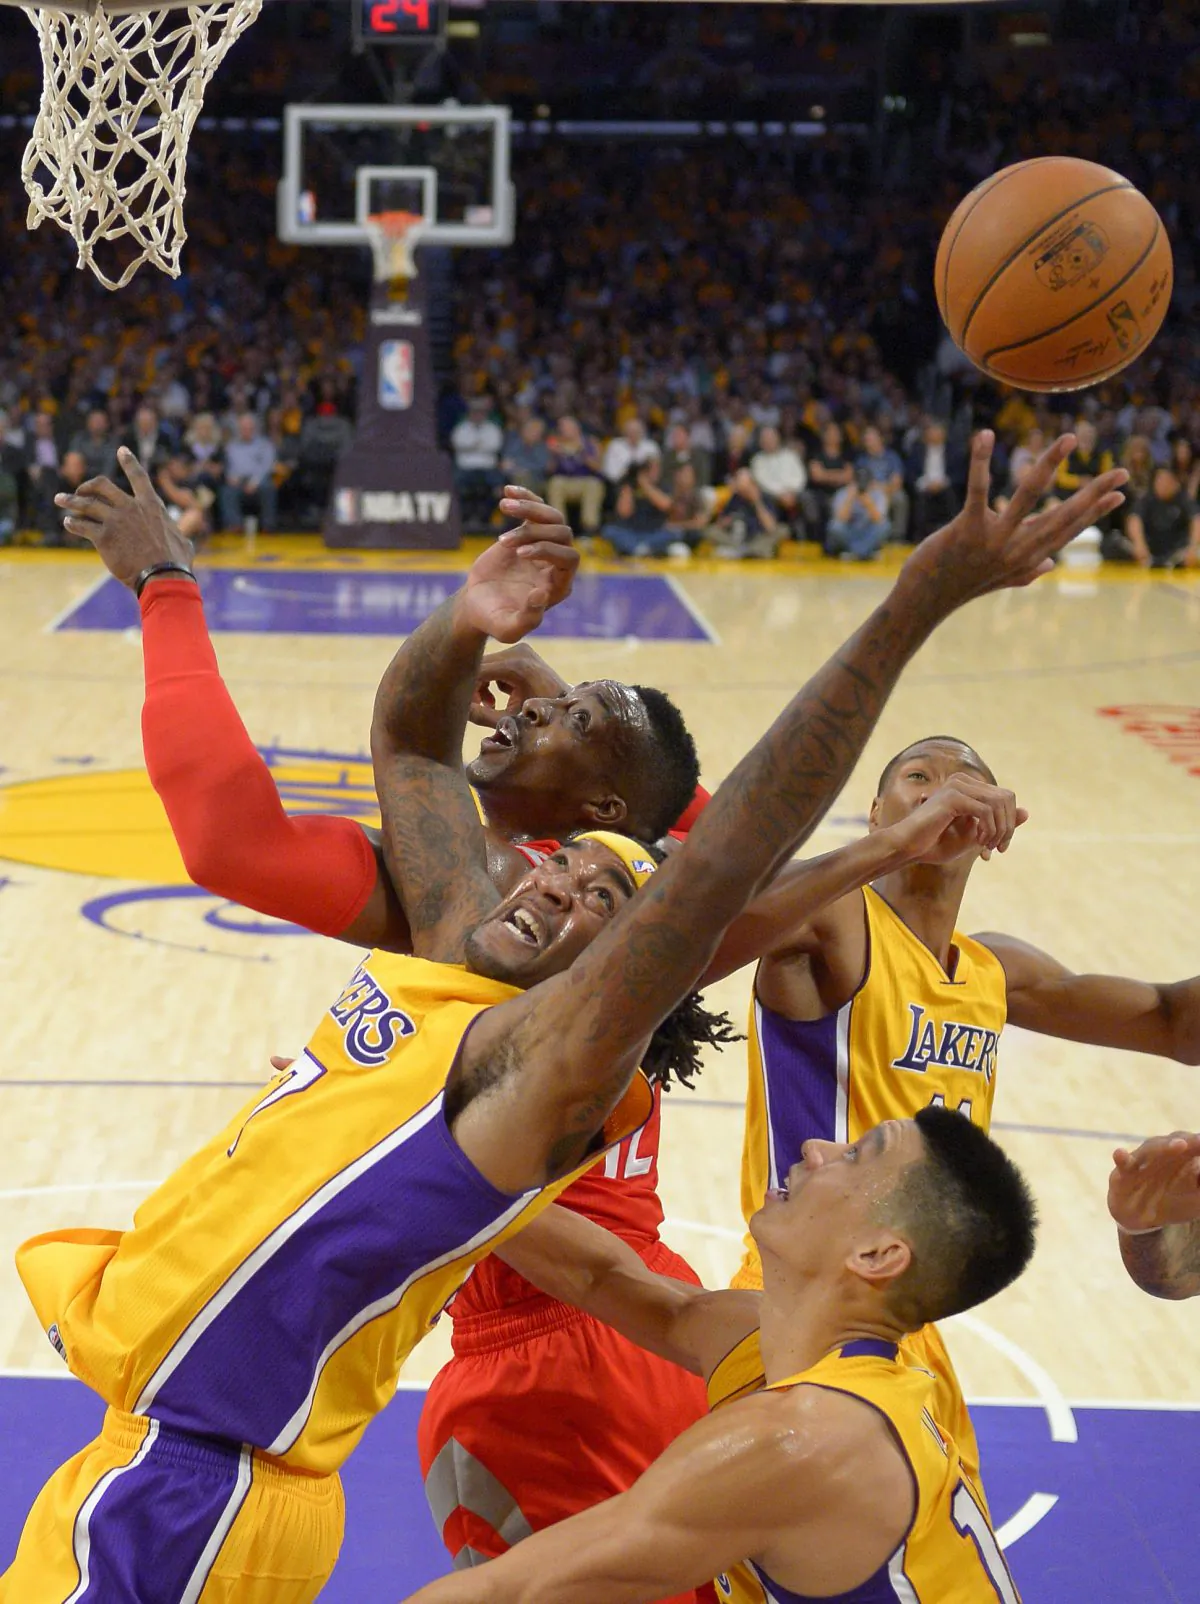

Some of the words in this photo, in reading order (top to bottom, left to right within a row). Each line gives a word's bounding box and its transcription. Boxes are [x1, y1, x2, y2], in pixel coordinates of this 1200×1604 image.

[369, 0, 429, 32] 24
[361, 491, 414, 523] NBA
[415, 491, 450, 524] TV
[330, 955, 416, 1066] ERS
